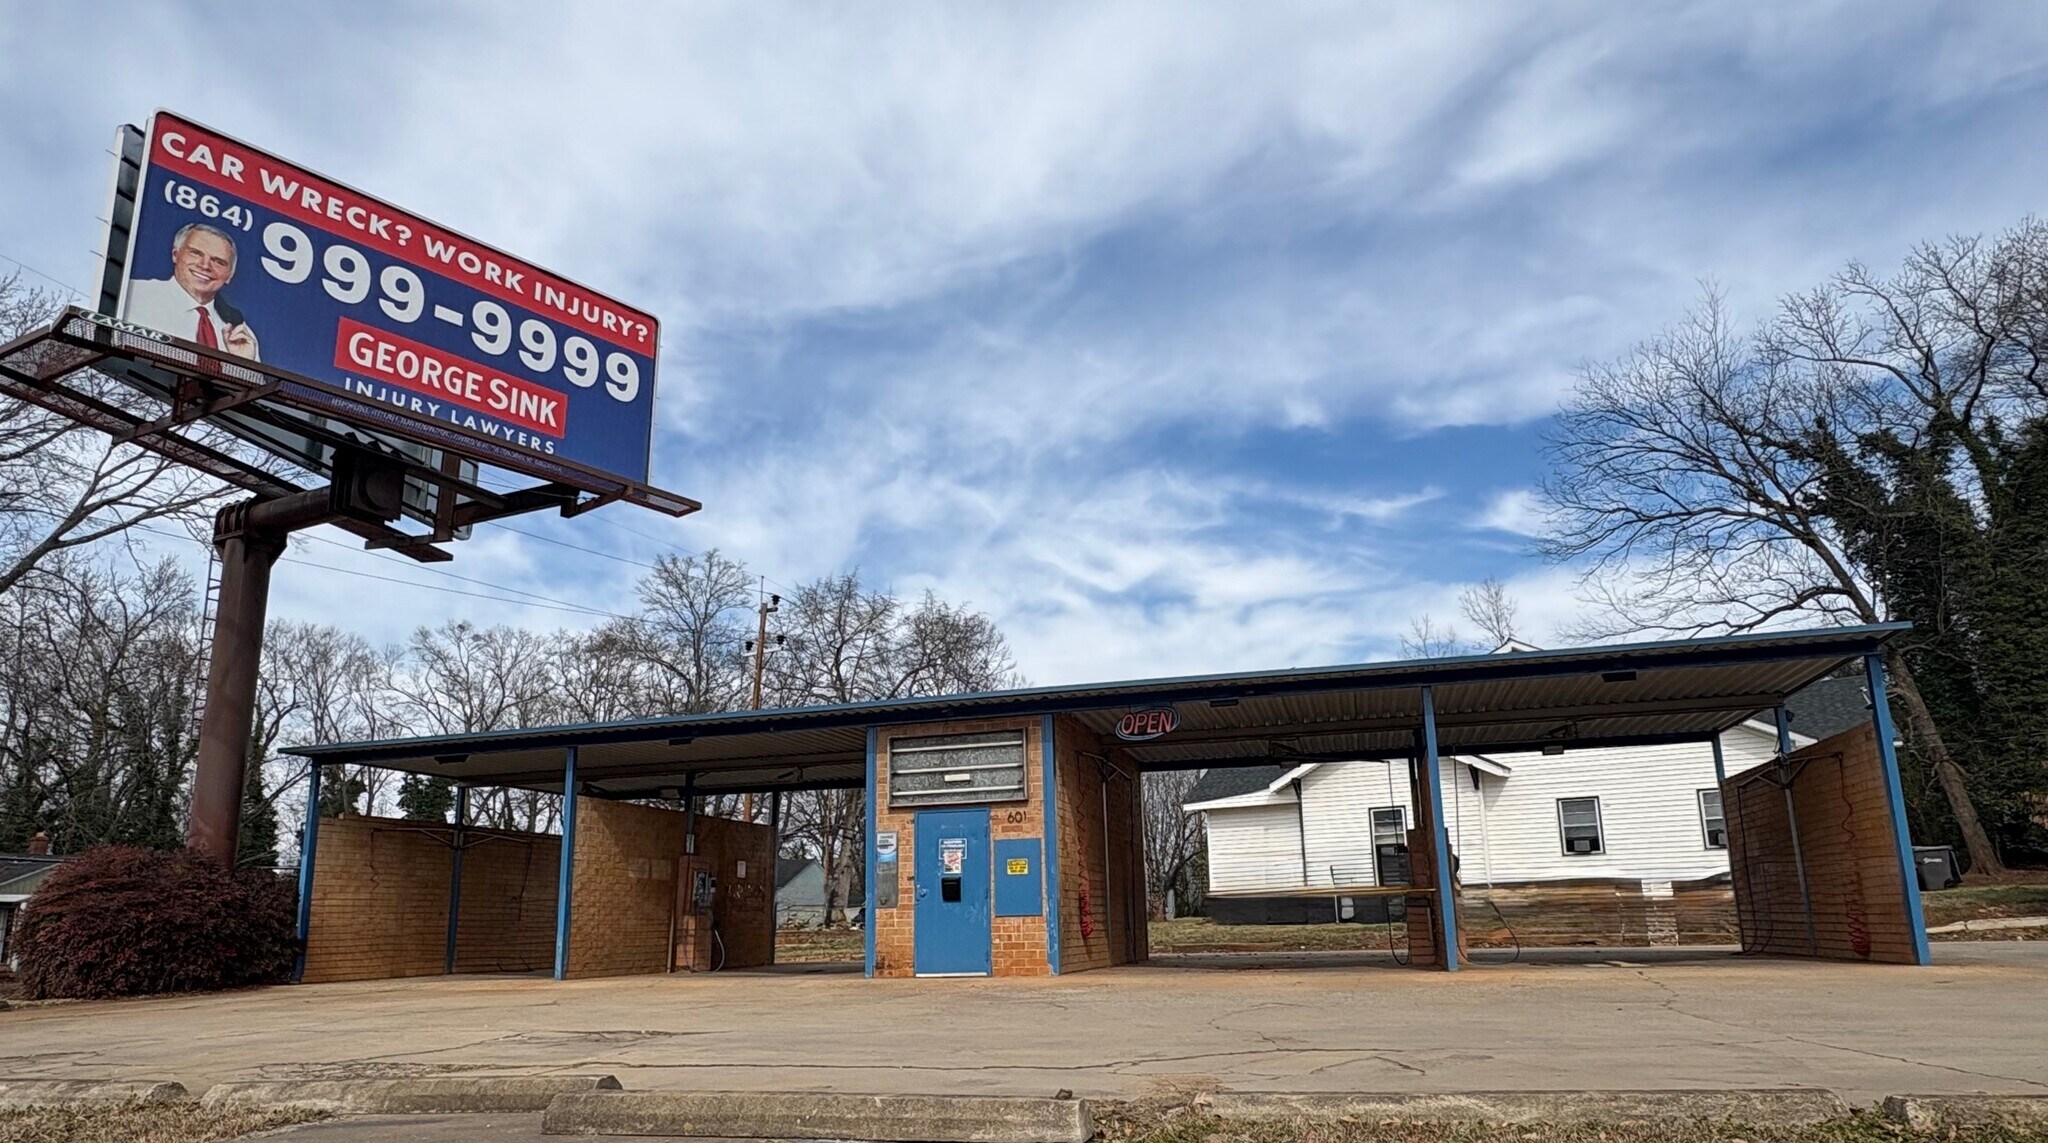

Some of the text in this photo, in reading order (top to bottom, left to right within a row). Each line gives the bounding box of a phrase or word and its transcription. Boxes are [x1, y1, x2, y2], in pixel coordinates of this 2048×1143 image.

[160, 131, 650, 344] CAR WRECK? WORK INJURY?
[163, 179, 254, 233] (864)
[87, 313, 165, 342] LAMAR
[260, 221, 641, 403] 999-9999
[349, 332, 559, 429] GEORGE SINK
[344, 377, 441, 417] INJURY
[451, 409, 556, 455] LAWYERS
[1121, 711, 1173, 735] OPEN
[1007, 810, 1027, 824] 601
